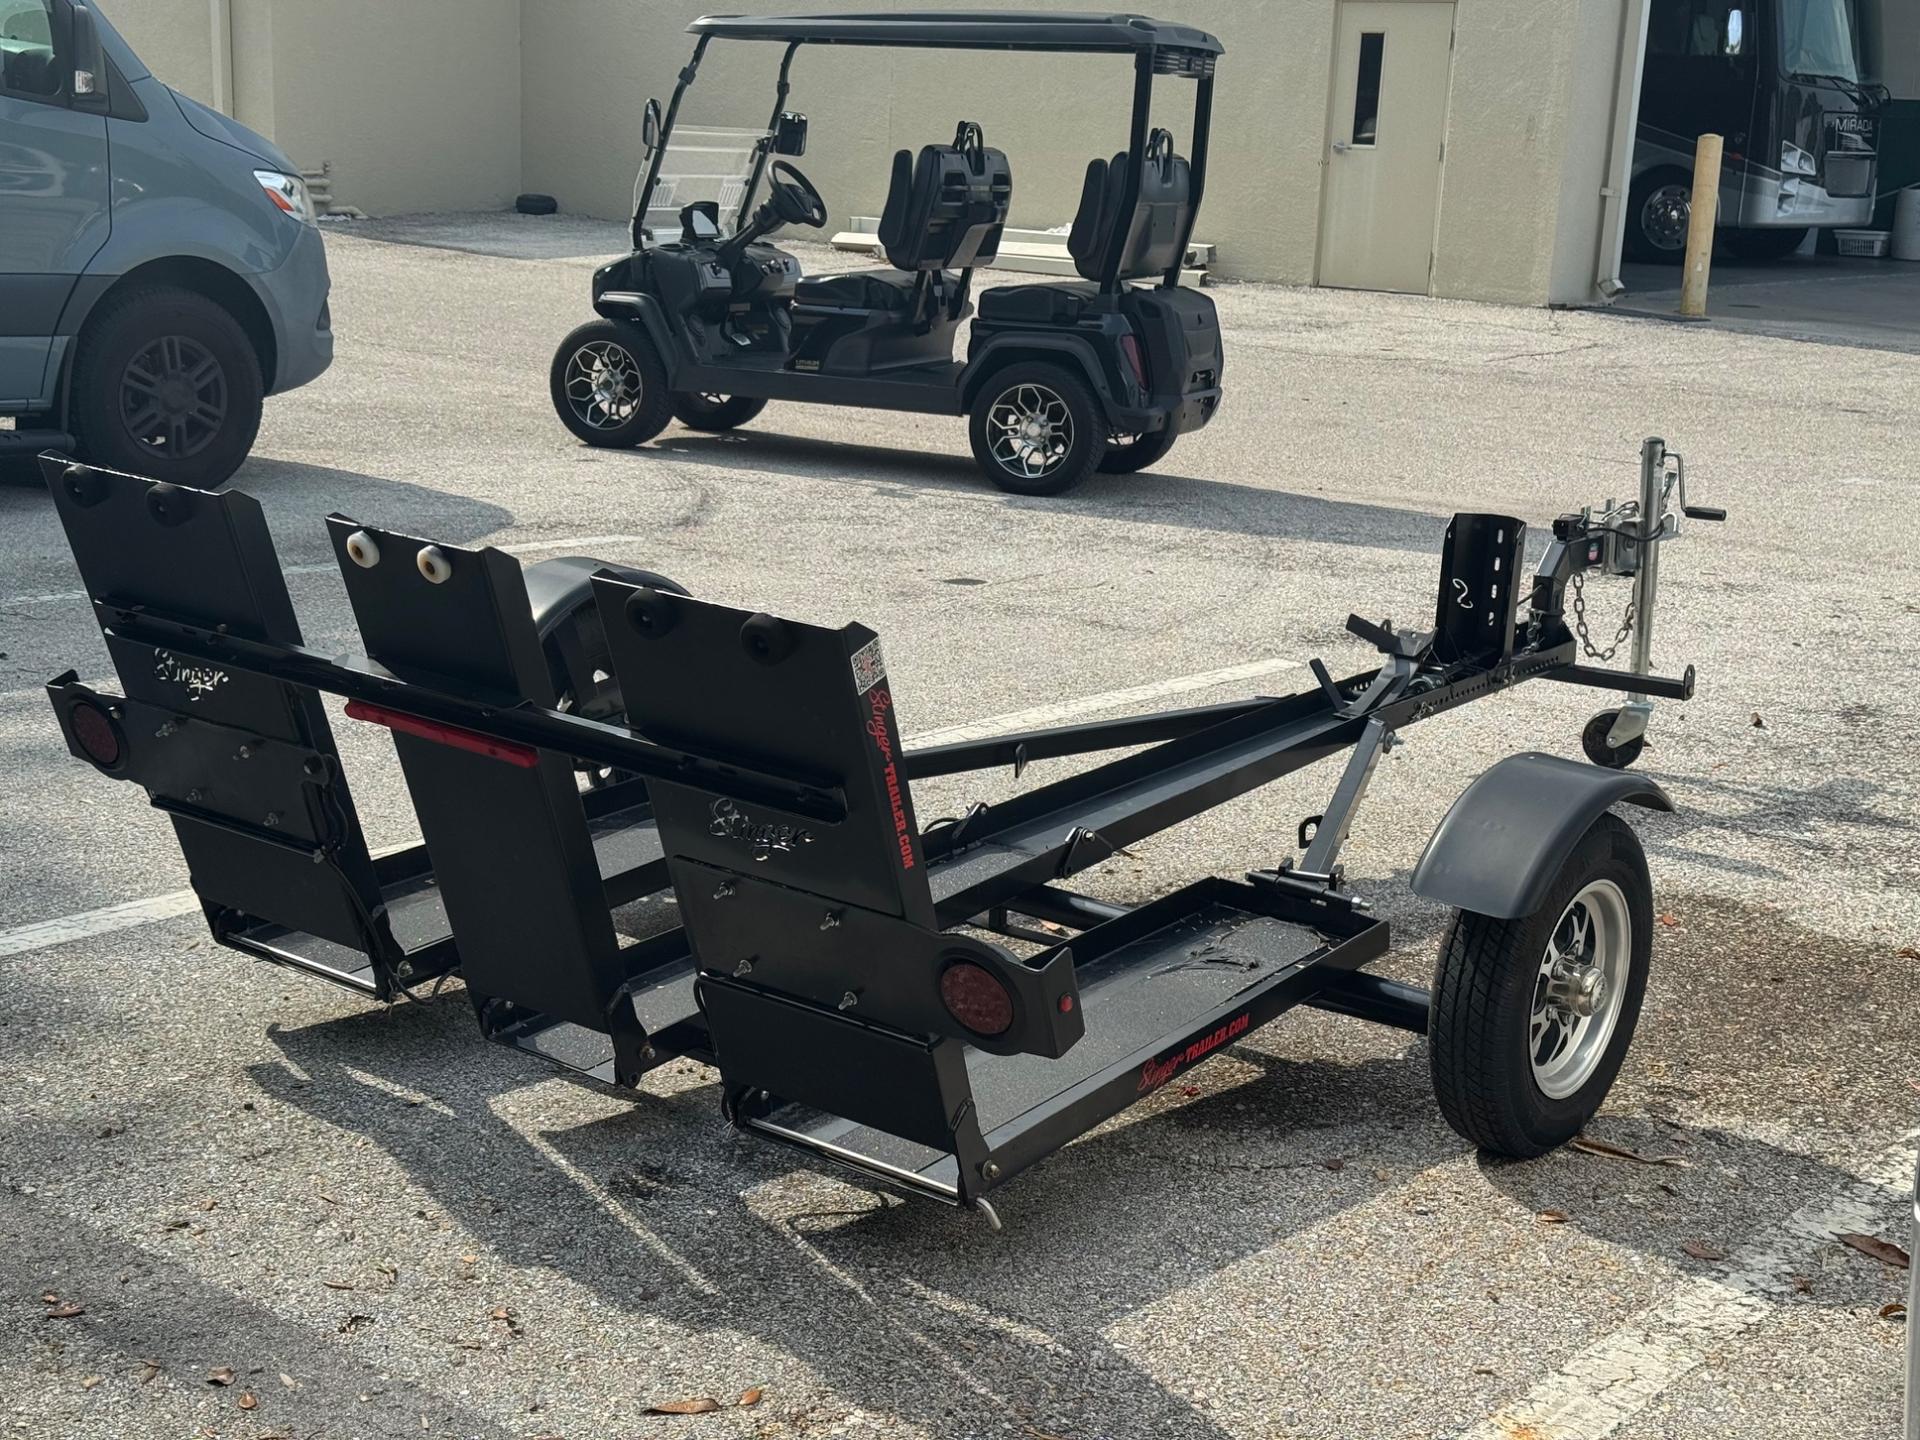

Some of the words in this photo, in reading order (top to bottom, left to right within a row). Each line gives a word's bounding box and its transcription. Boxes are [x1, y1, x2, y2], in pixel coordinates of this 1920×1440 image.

[154, 647, 229, 701] Stinger
[867, 688, 892, 763] Stinger
[884, 761, 914, 870] TRAILER.COM
[709, 797, 815, 861] Stinger
[1185, 1013, 1249, 1063] TRAILER.COM
